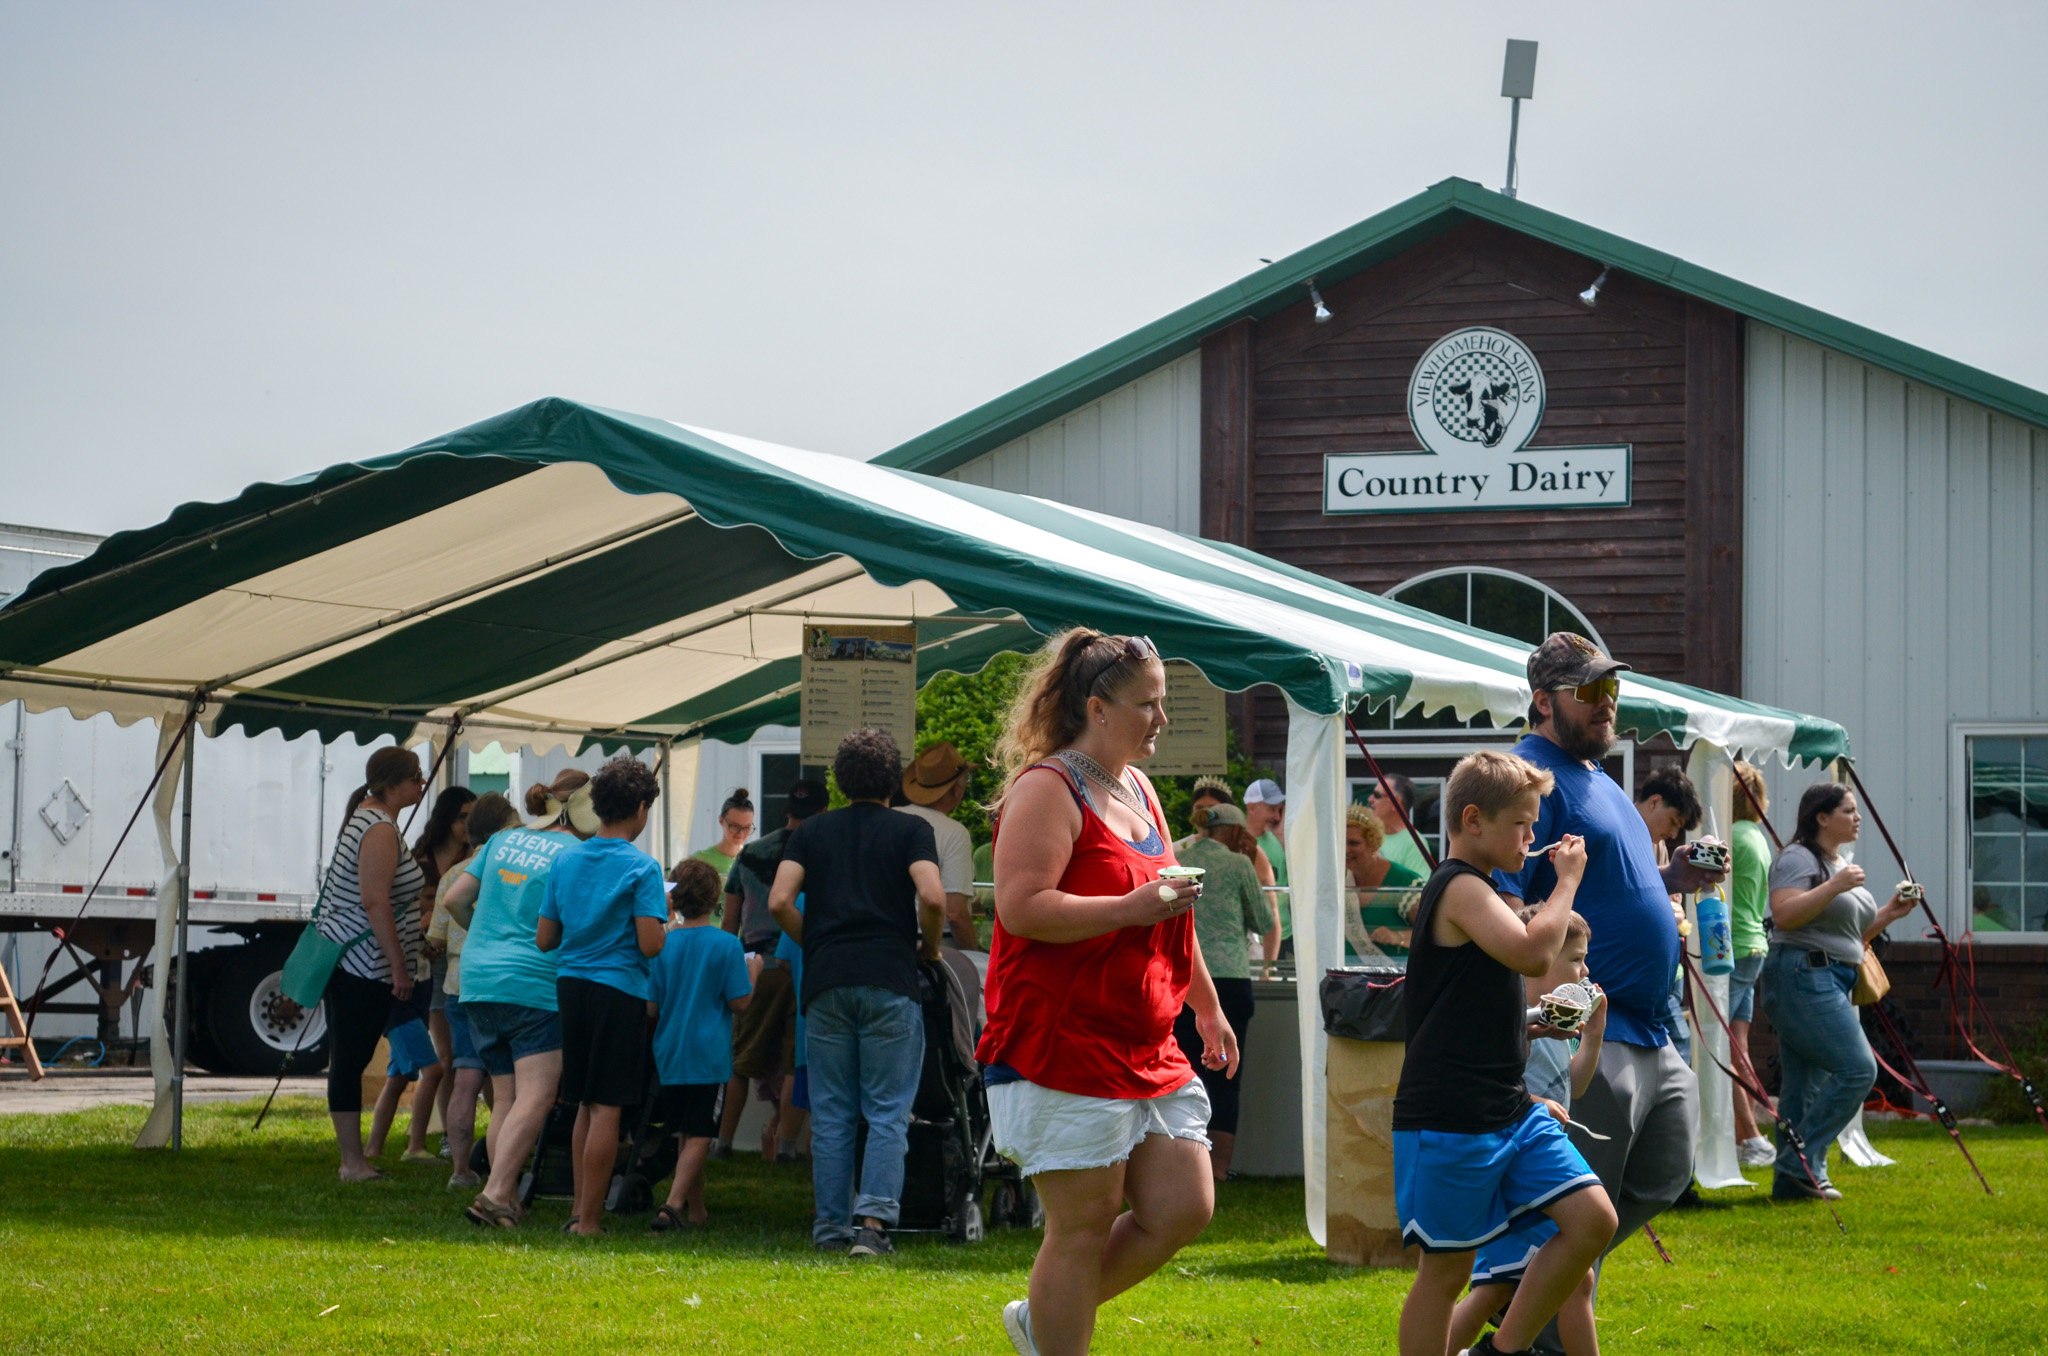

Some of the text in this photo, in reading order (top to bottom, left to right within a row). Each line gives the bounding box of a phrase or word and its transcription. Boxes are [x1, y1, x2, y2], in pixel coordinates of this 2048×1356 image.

[1337, 461, 1615, 501] Country Dairy
[504, 831, 564, 856] EVENT
[494, 846, 550, 871] STAFF
